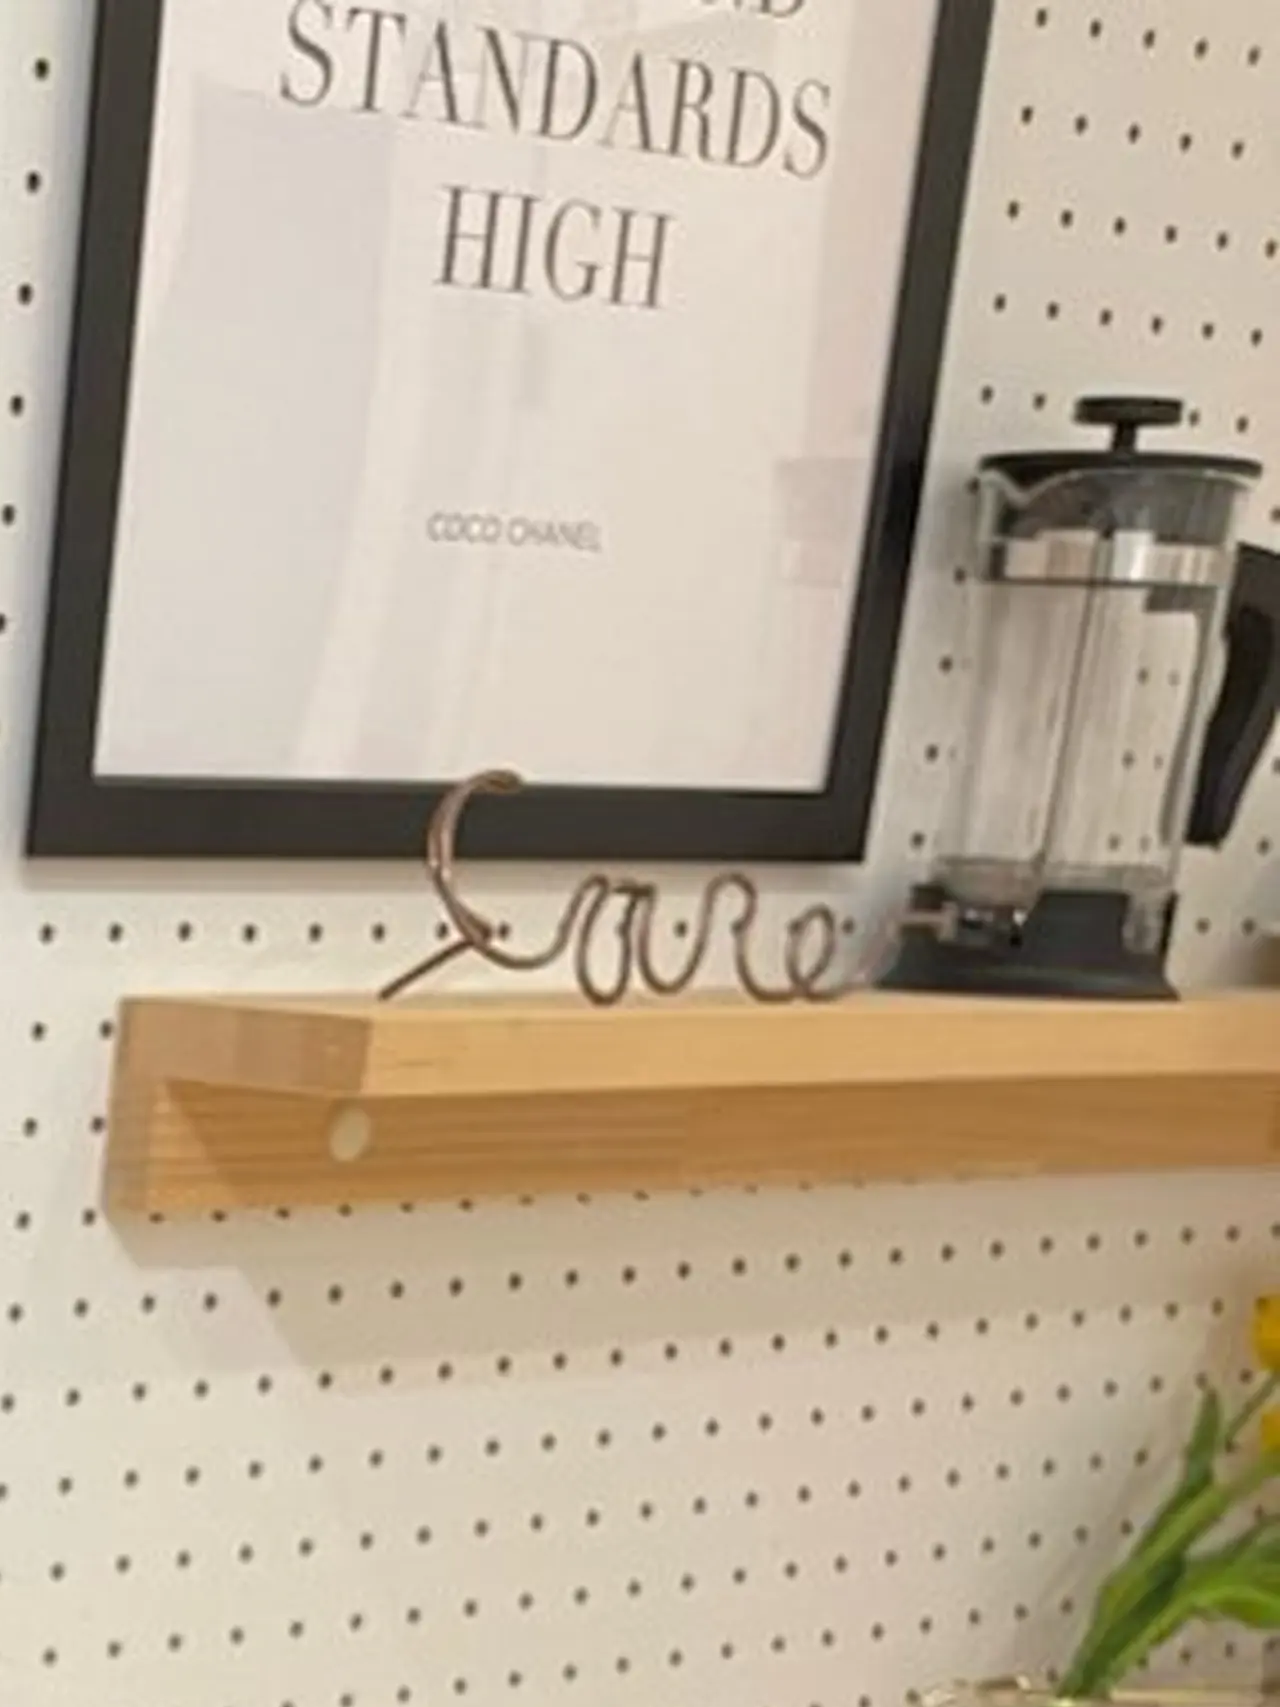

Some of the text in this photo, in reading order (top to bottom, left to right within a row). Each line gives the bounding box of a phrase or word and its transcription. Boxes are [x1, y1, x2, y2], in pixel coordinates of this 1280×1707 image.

[279, 0, 832, 180] STANDARDS
[433, 185, 676, 309] HIGH
[426, 511, 503, 544] COCO
